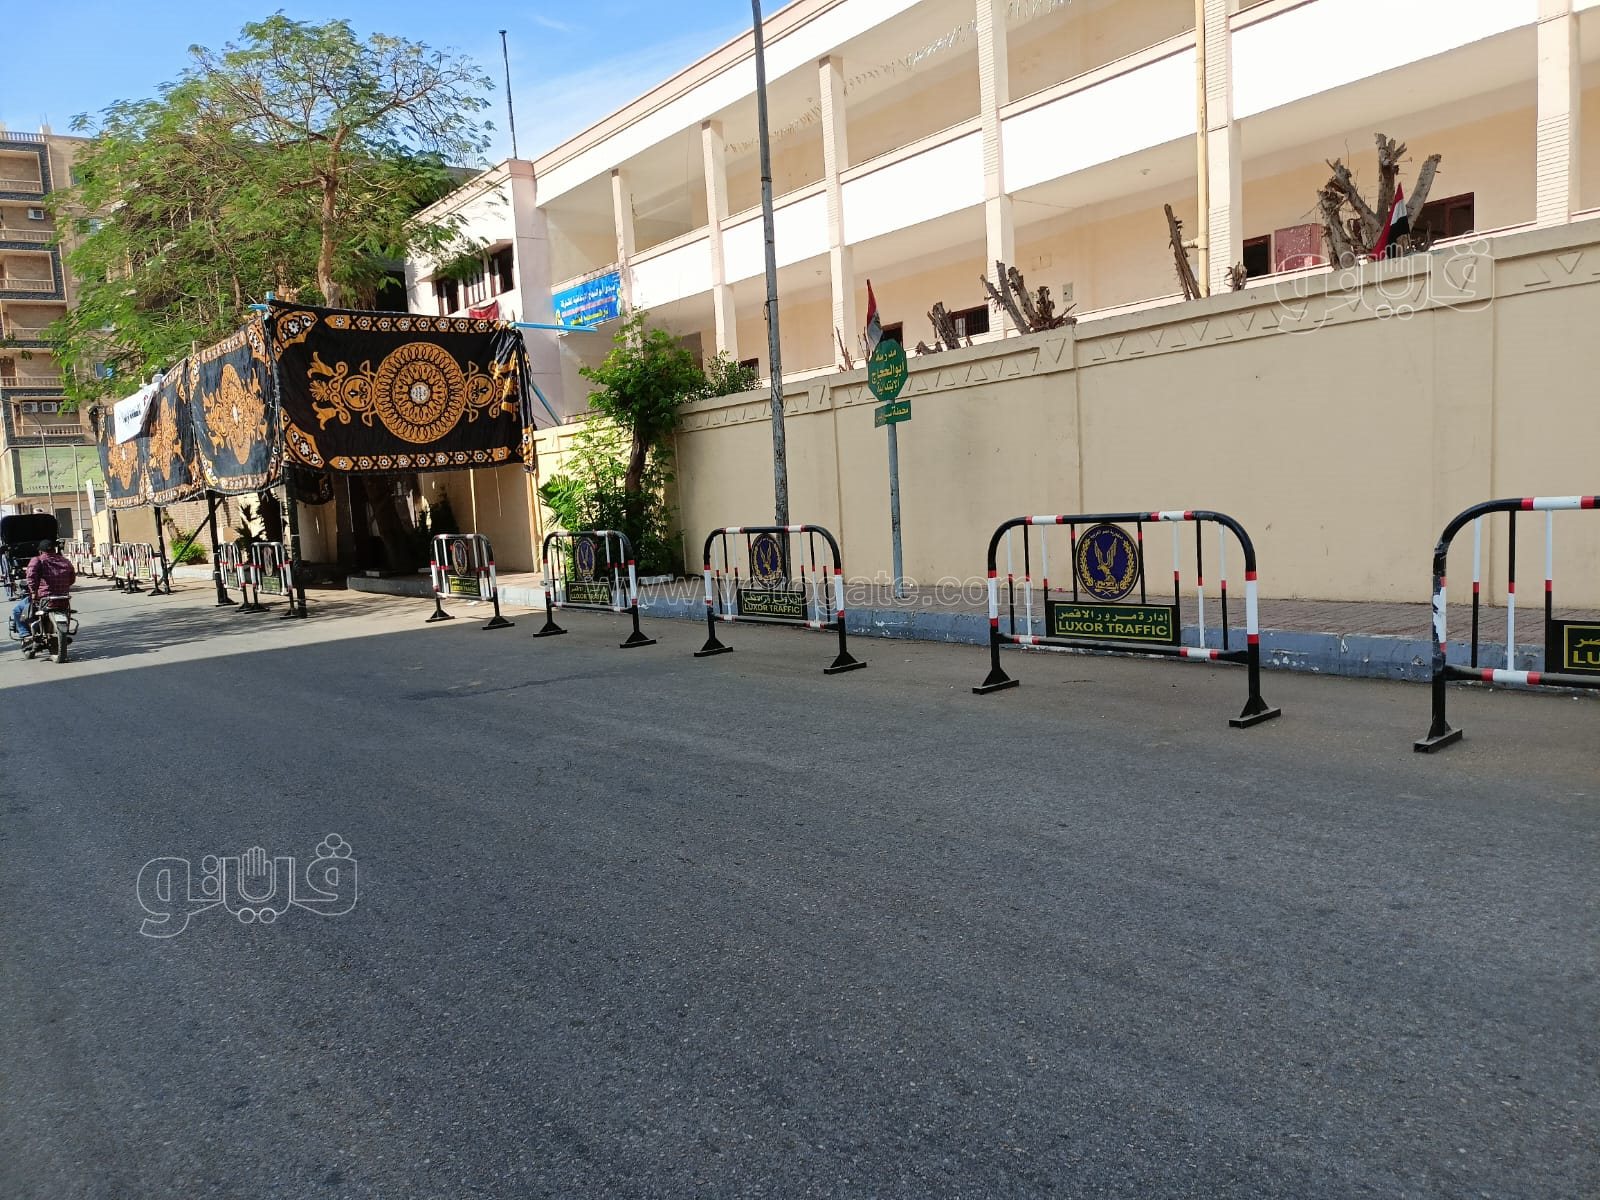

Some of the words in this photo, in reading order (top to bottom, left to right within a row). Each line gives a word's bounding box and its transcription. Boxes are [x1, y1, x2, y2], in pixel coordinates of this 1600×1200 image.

[744, 603, 768, 611] LUXOR
[769, 605, 800, 613] TRAFFIC
[1058, 620, 1103, 632] LUXOR
[1106, 623, 1168, 636] TRAFFIC
